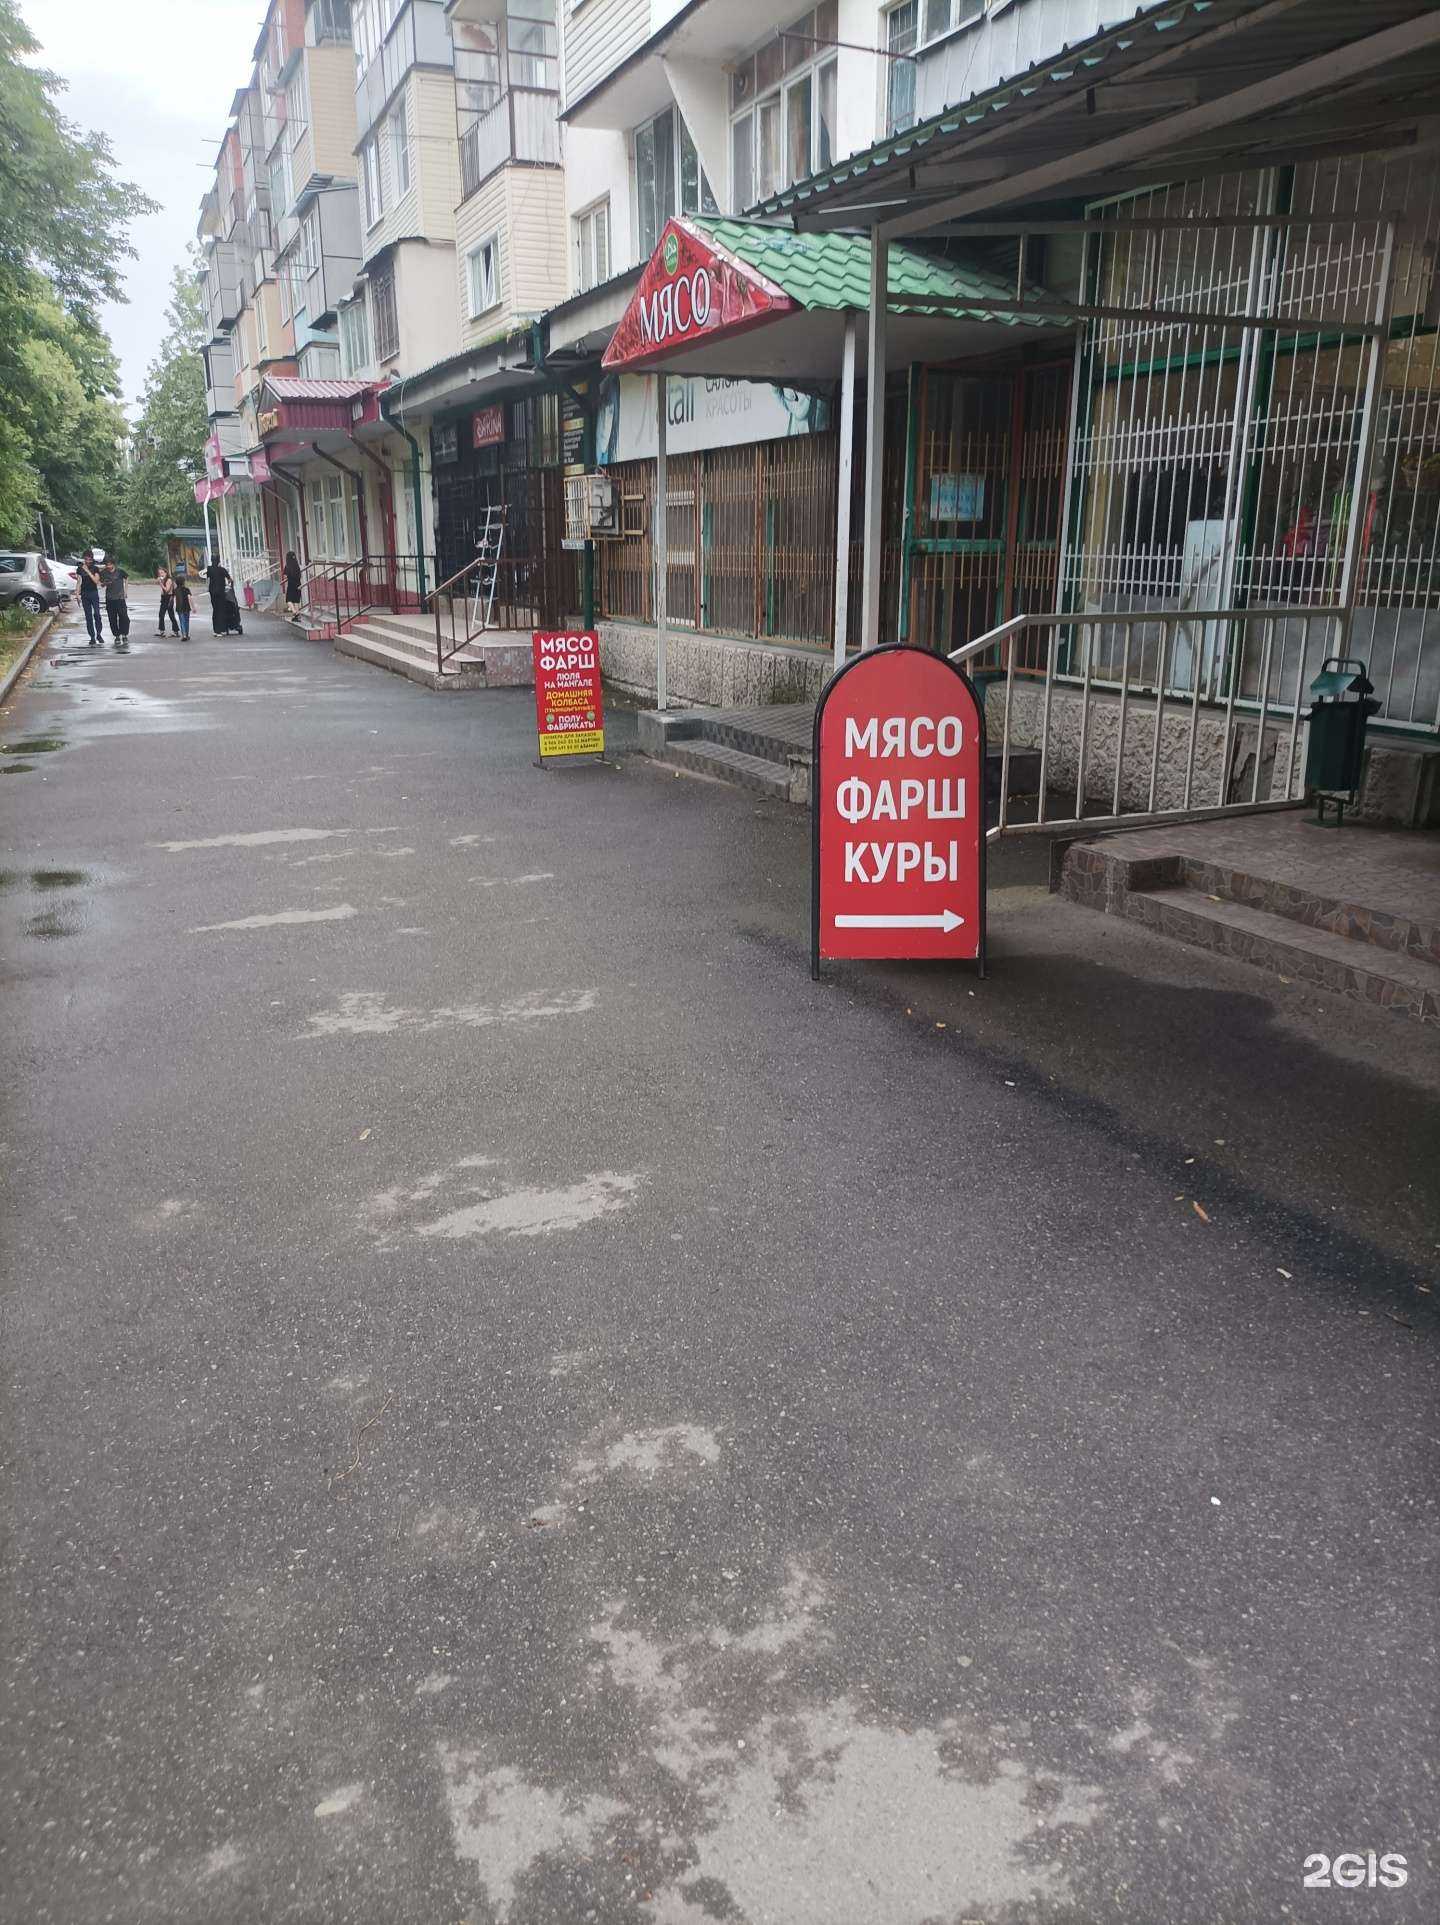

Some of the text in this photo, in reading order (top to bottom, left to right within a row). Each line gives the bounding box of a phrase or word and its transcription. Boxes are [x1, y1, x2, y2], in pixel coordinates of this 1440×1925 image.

[640, 267, 711, 345] МЯСО
[540, 636, 593, 653] МЯСО
[540, 653, 595, 671] ФАРШ
[544, 679, 593, 689] НА МАНГАЛЕ
[556, 672, 581, 681] ЛЮЛЯ
[545, 689, 593, 700] ДОМАШНЯЯ
[551, 698, 589, 707] КОЛБАСА
[547, 721, 596, 731] ФАБРИКАТЫ
[844, 716, 963, 758] МЯСО
[836, 776, 966, 824] ФАРШ
[844, 840, 959, 883] КУРЫ
